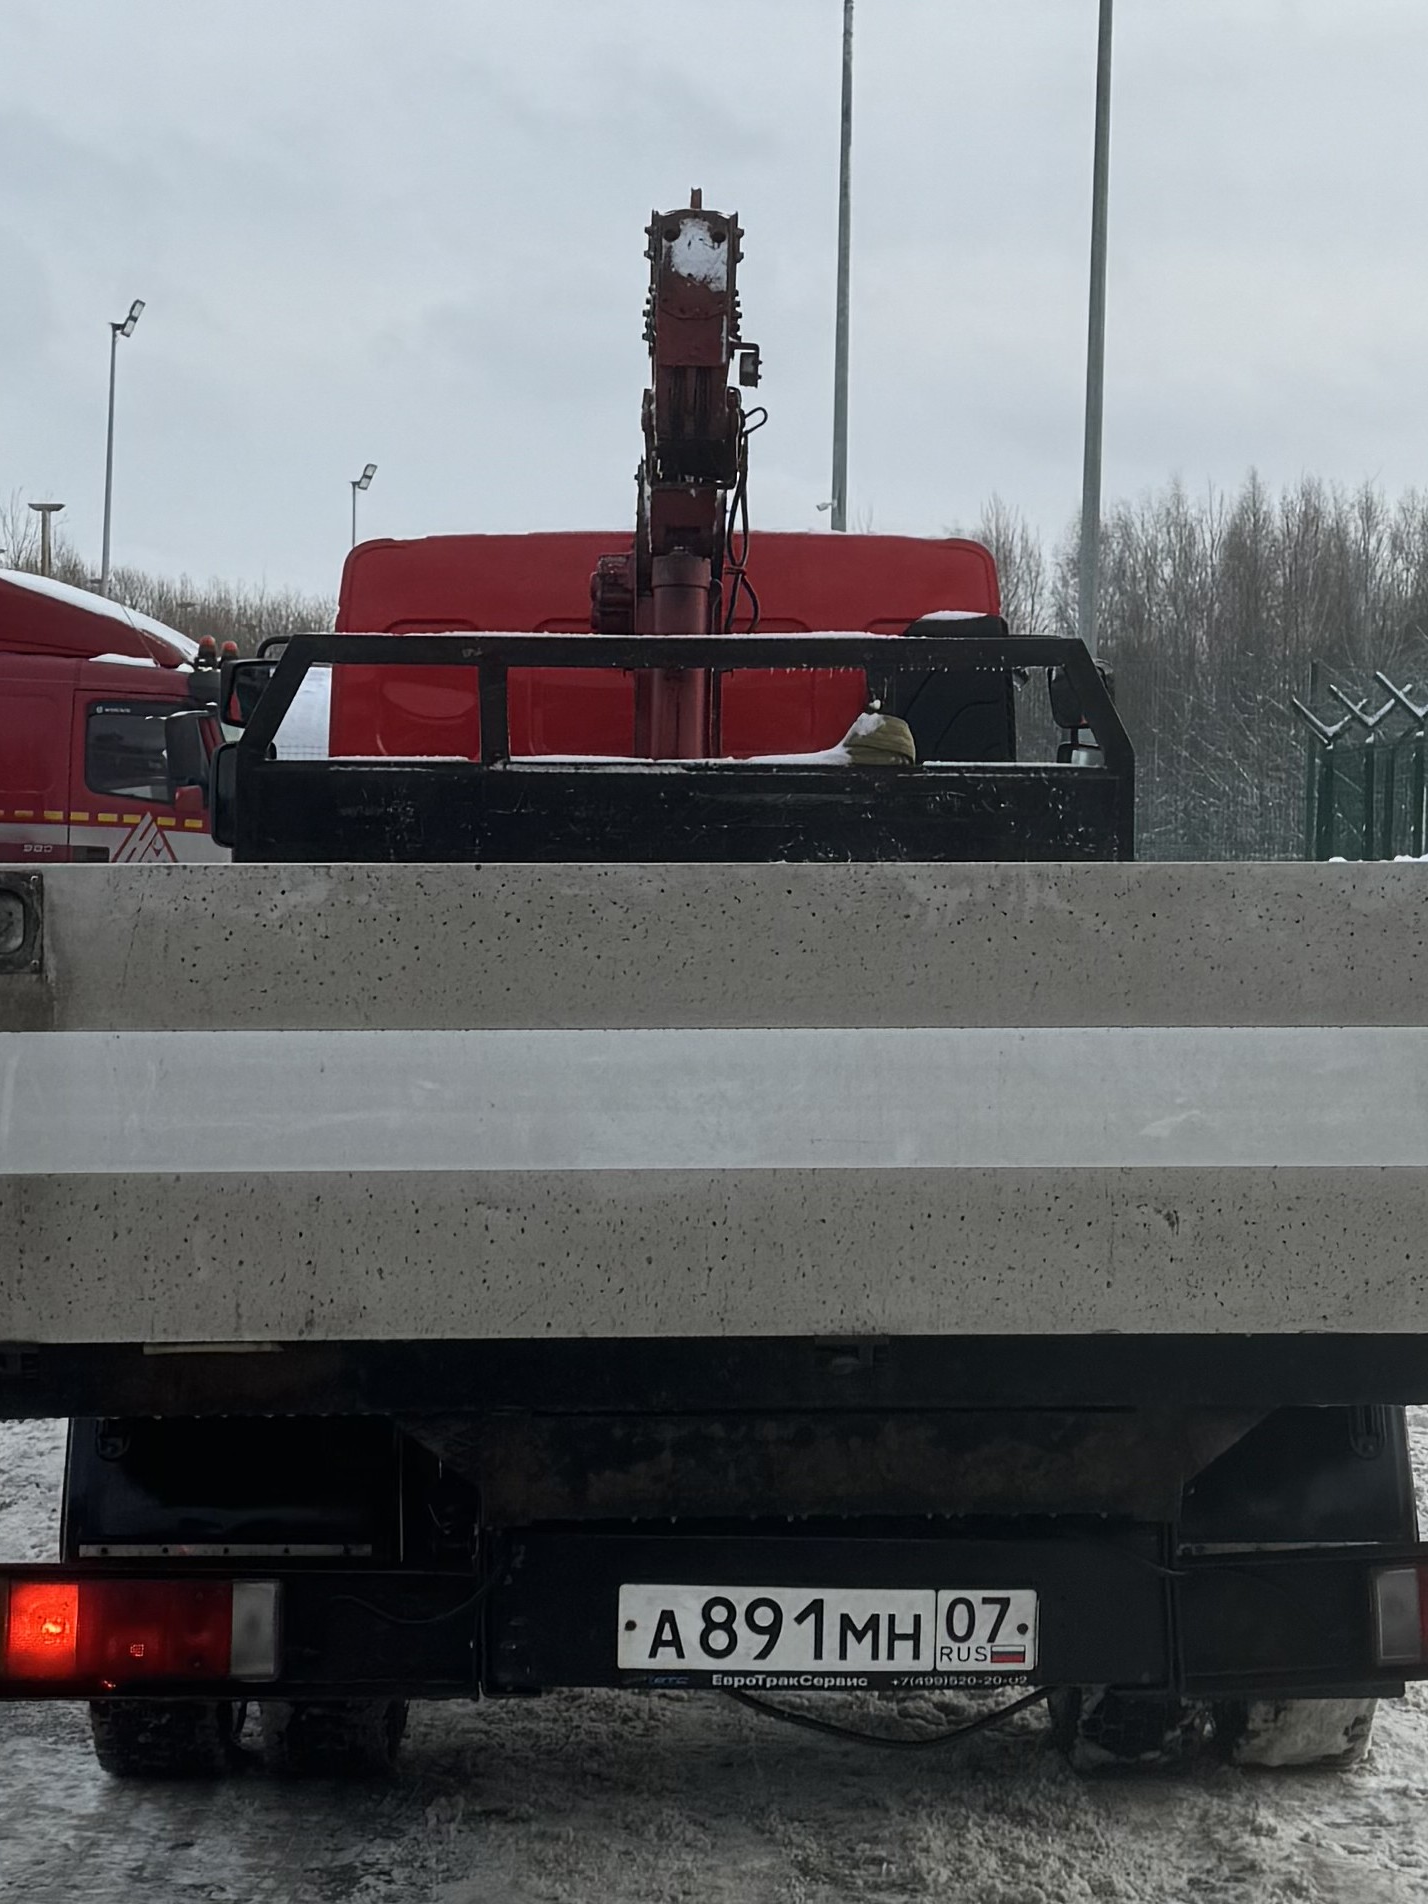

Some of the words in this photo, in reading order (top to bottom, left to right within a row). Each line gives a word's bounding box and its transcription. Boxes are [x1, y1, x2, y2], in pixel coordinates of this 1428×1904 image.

[648, 1596, 922, 1660] А891МН
[945, 1597, 1011, 1644] 07
[940, 1646, 988, 1662] RUS
[712, 1674, 868, 1689] ЕвроТракСервис
